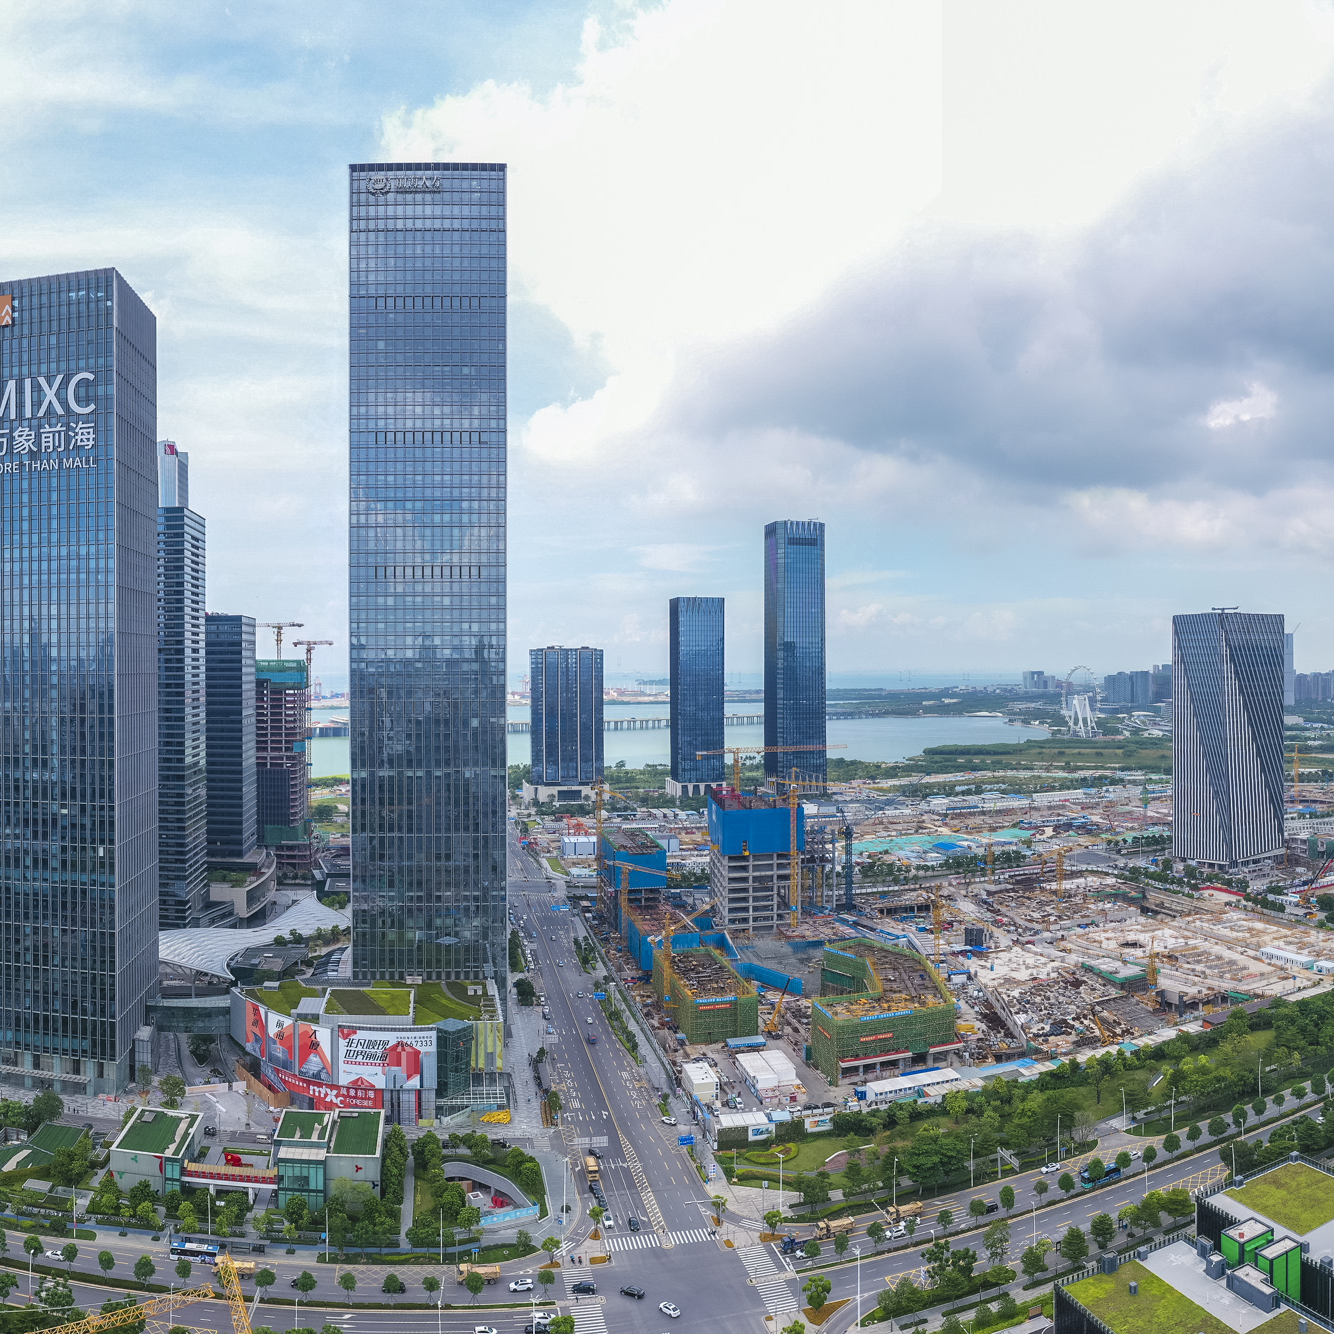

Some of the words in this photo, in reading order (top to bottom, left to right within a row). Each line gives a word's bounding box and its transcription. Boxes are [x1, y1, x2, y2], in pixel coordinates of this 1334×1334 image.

[23, 458, 59, 472] THAN
[63, 456, 97, 469] MALL
[275, 1019, 285, 1040] 前海
[344, 1049, 390, 1061] 世界前海
[346, 1098, 373, 1107] FORESEE
